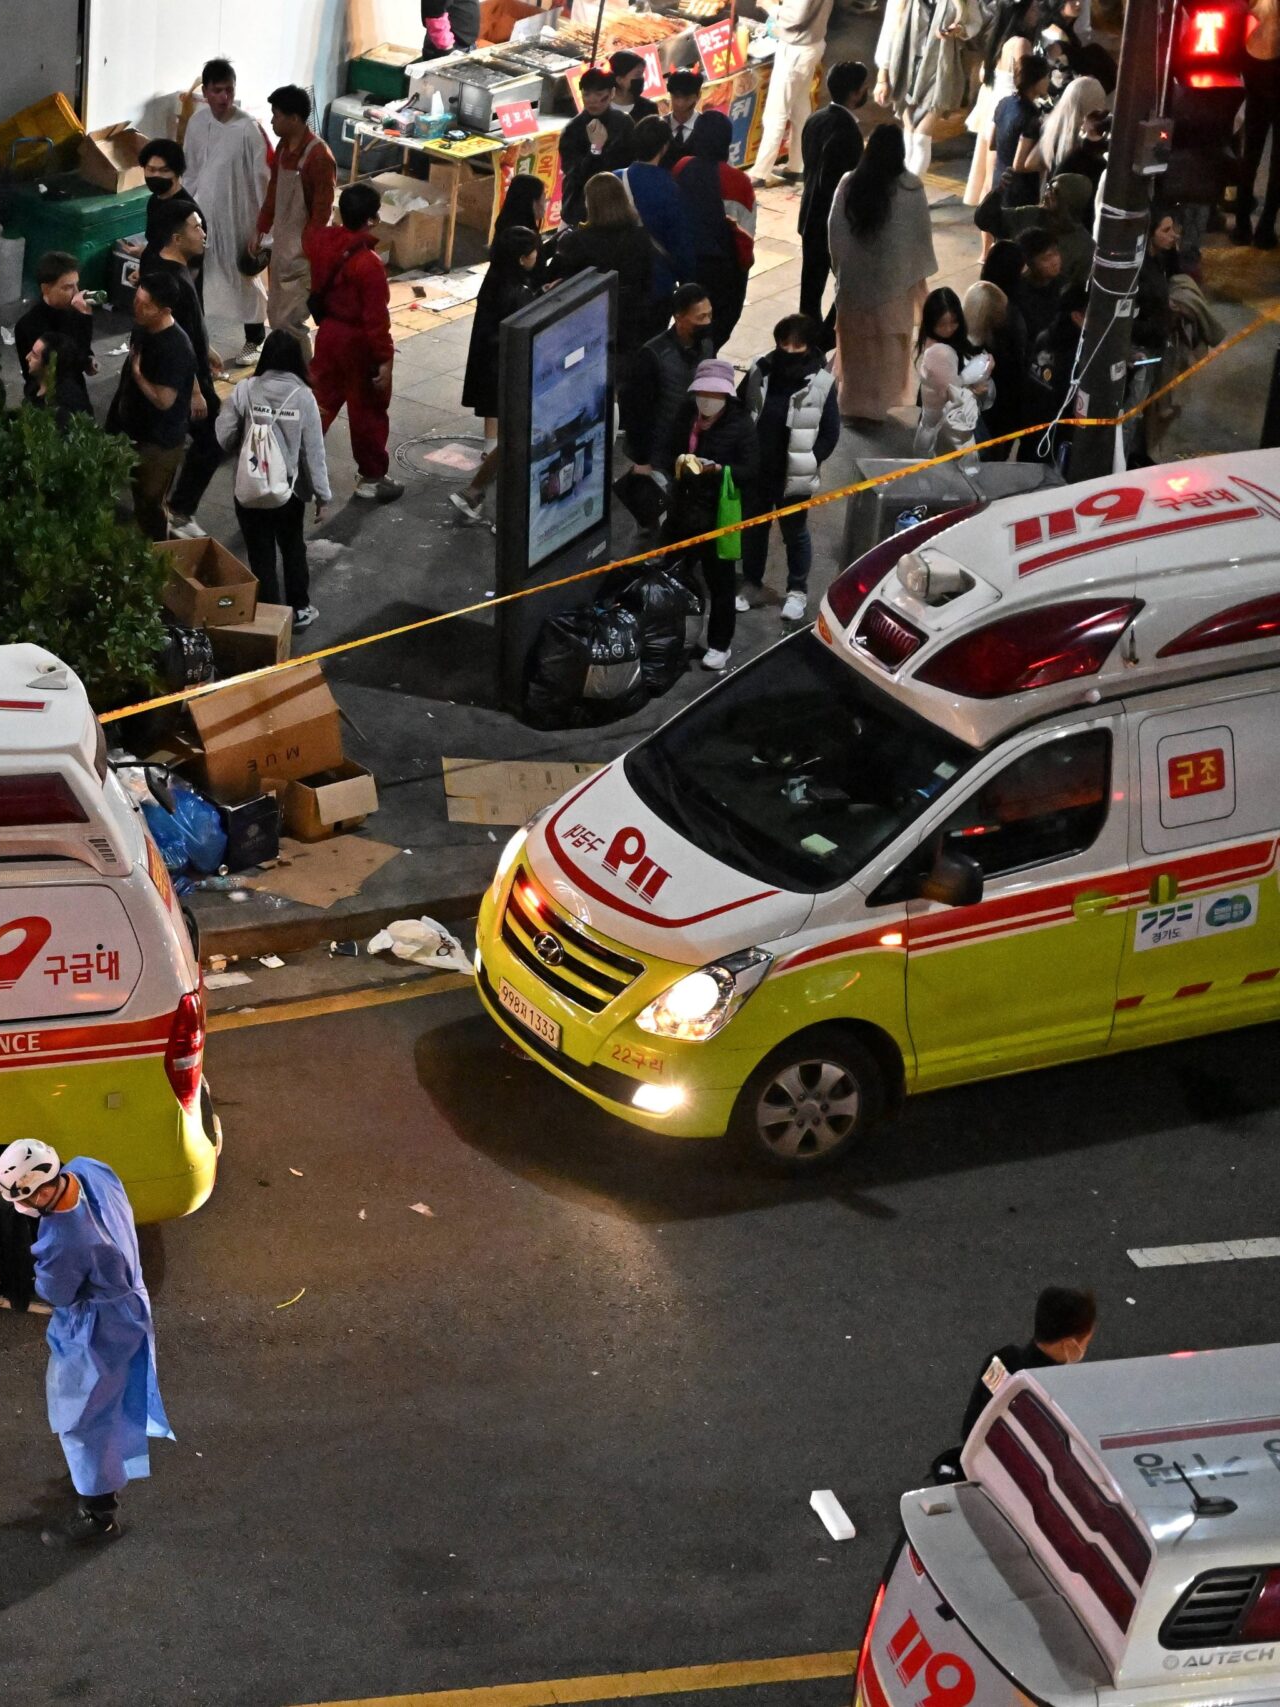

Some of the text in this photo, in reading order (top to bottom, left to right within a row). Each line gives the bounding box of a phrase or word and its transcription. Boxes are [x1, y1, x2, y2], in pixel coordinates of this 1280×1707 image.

[1005, 487, 1240, 551] 119 구급대
[1176, 756, 1218, 791] 구조
[1152, 927, 1181, 944] 경기도
[43, 947, 120, 986] 구급대
[611, 1043, 664, 1075] 22구리
[886, 1608, 977, 1707] 119
[1182, 1647, 1275, 1669] AUTECH
